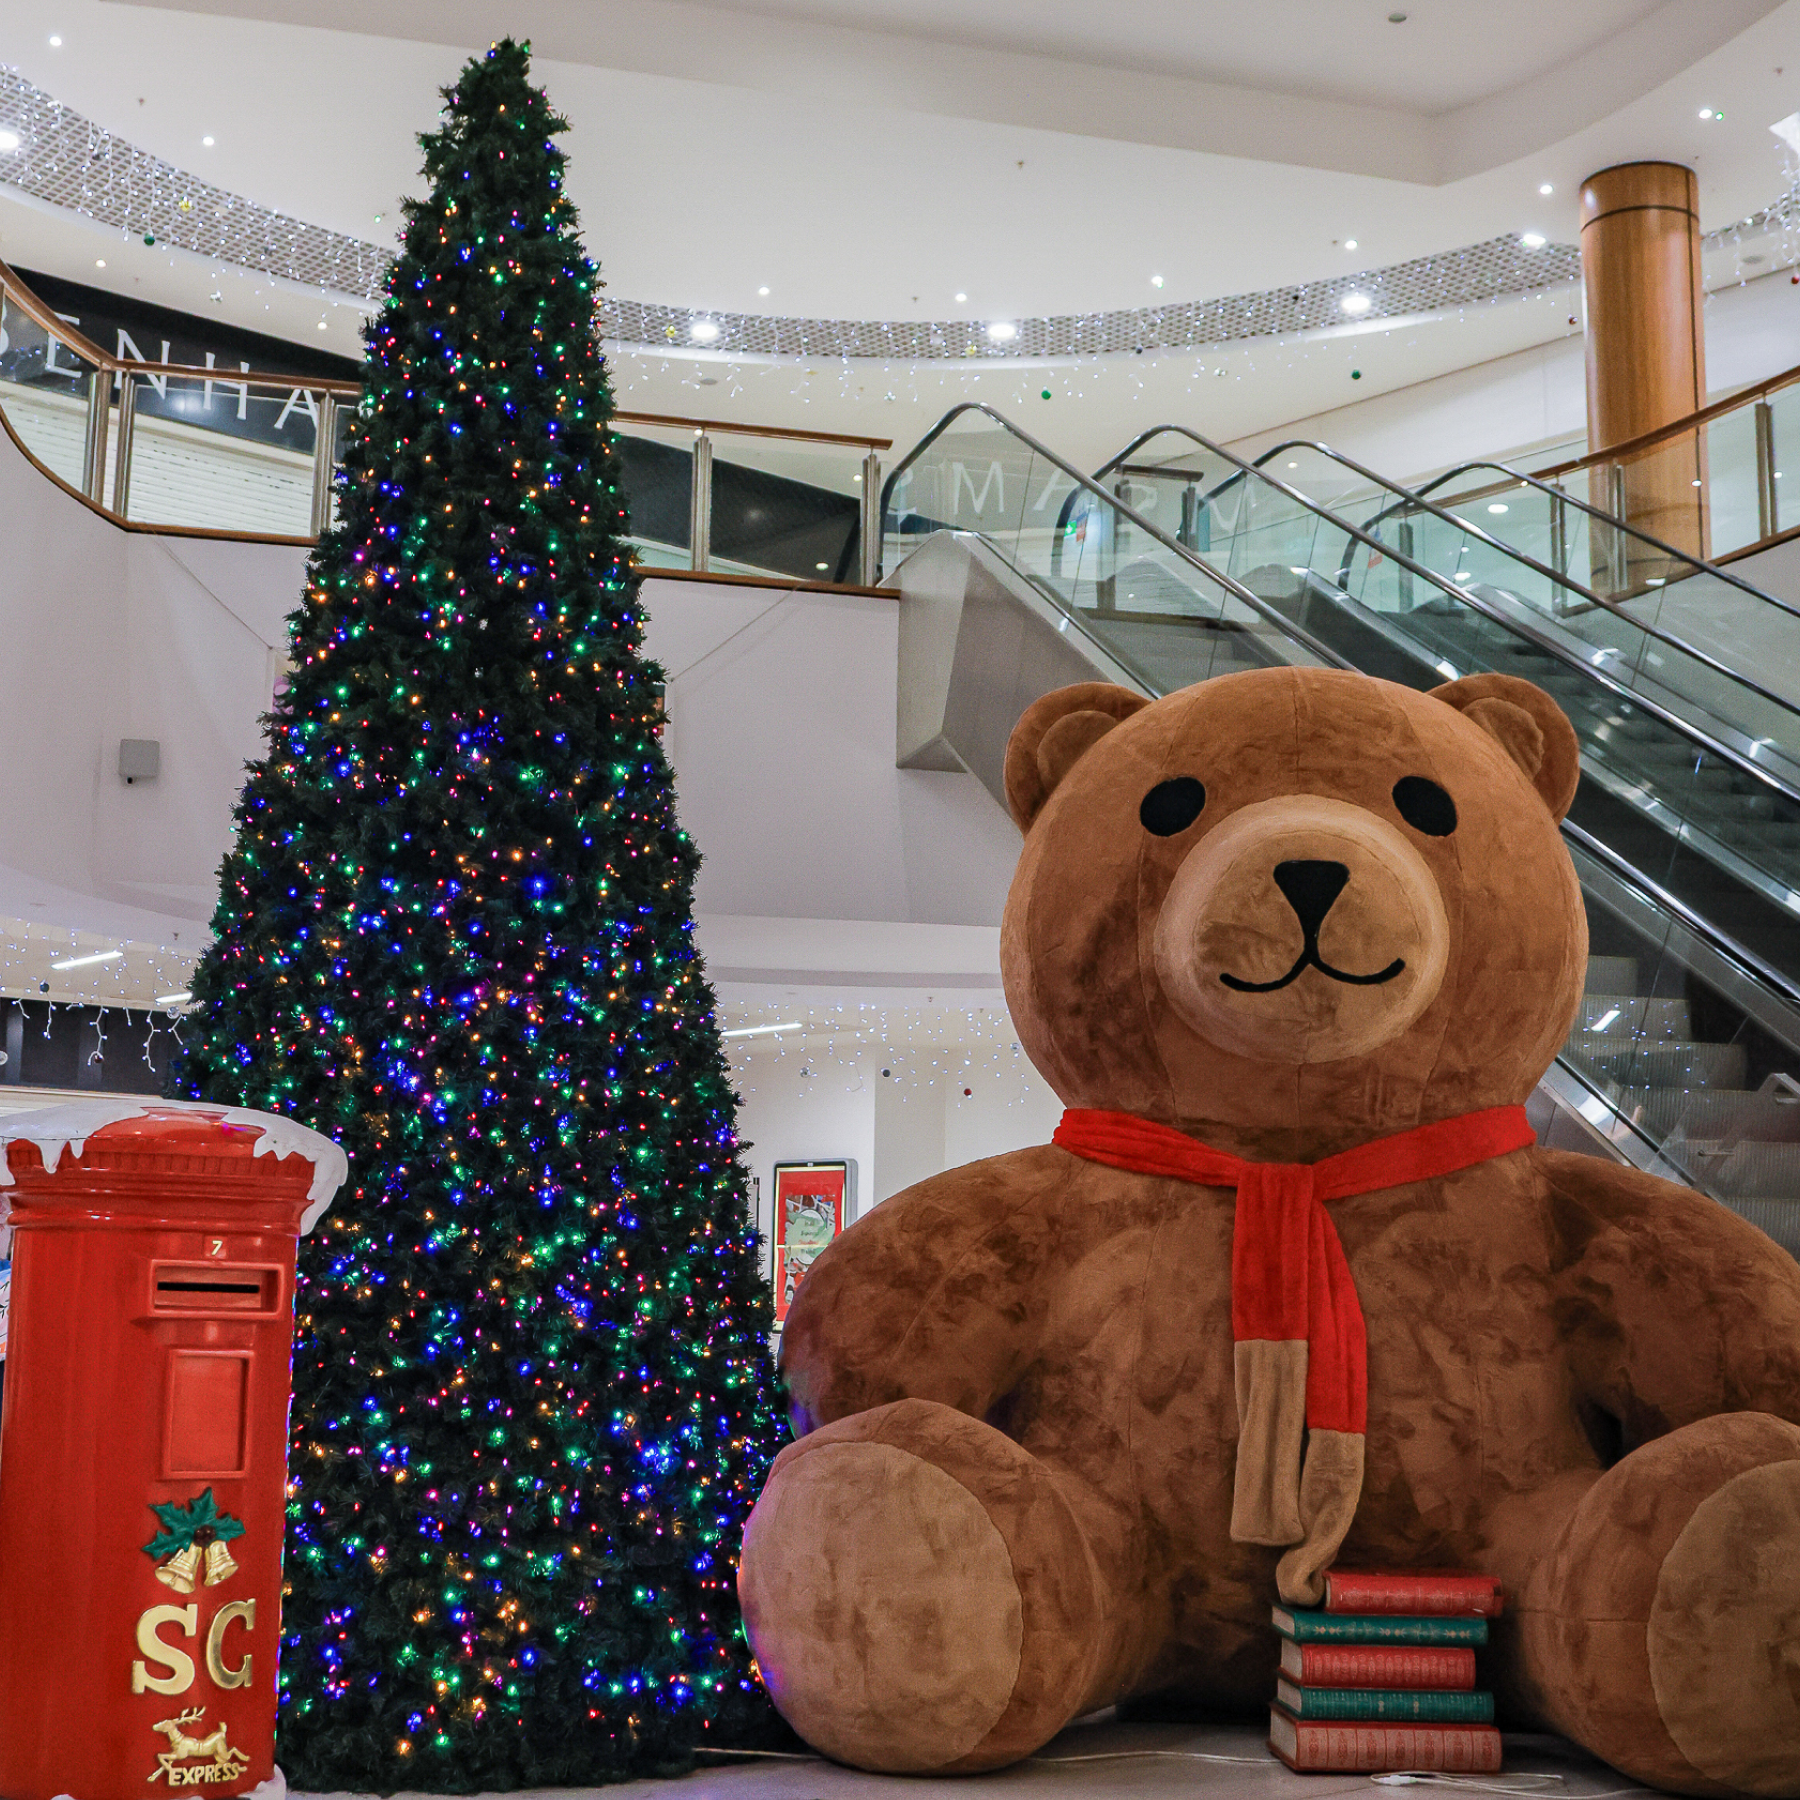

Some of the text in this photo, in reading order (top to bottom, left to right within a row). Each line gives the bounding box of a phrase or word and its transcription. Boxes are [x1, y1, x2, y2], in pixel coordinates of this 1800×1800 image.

[0, 303, 319, 430] ENHA
[212, 1240, 223, 1256] 7
[132, 1598, 256, 1696] SC
[168, 1762, 240, 1786] EXPRESS
